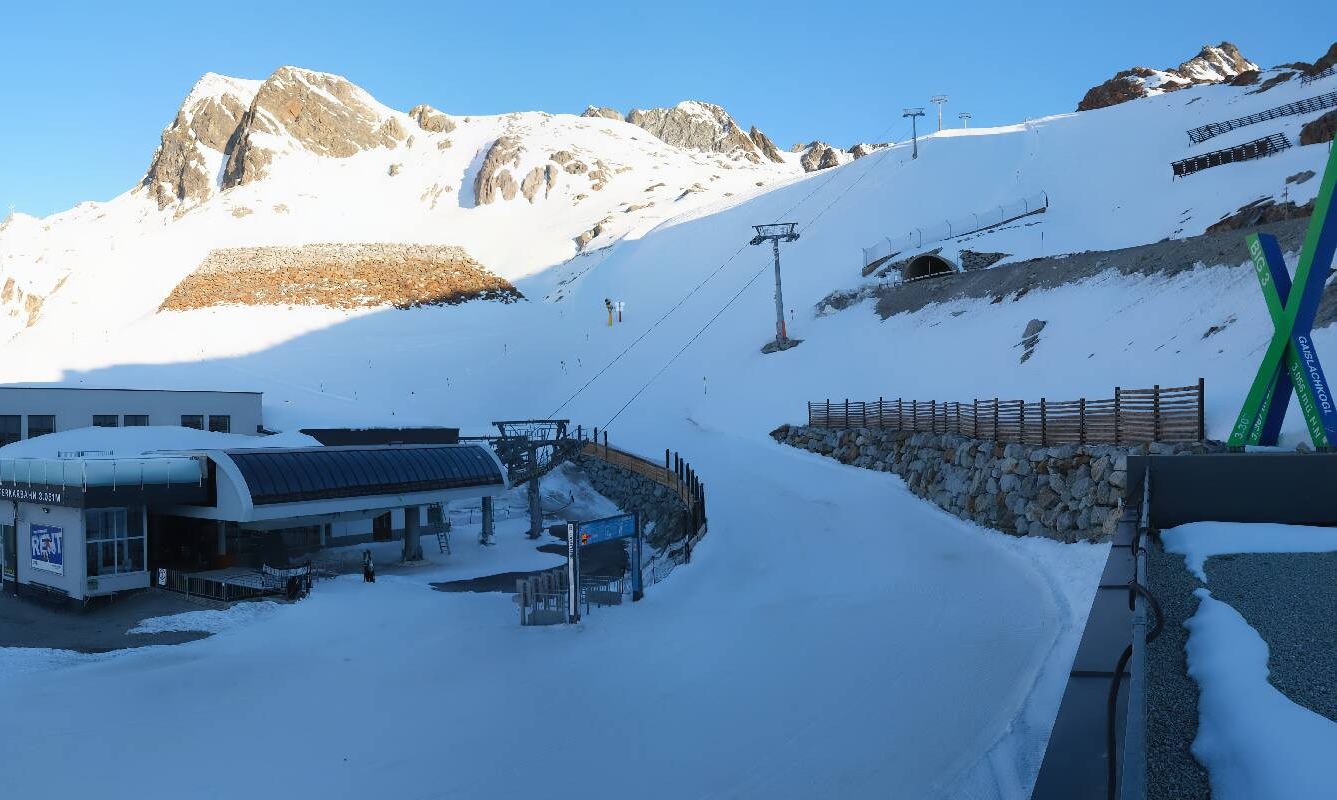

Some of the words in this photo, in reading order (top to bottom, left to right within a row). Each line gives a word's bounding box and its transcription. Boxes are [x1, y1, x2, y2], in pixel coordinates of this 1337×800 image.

[1251, 240, 1265, 272] BIG
[1261, 272, 1270, 286] 3
[1298, 336, 1333, 414] GAISLACHKOGL
[31, 532, 62, 557] RENT
